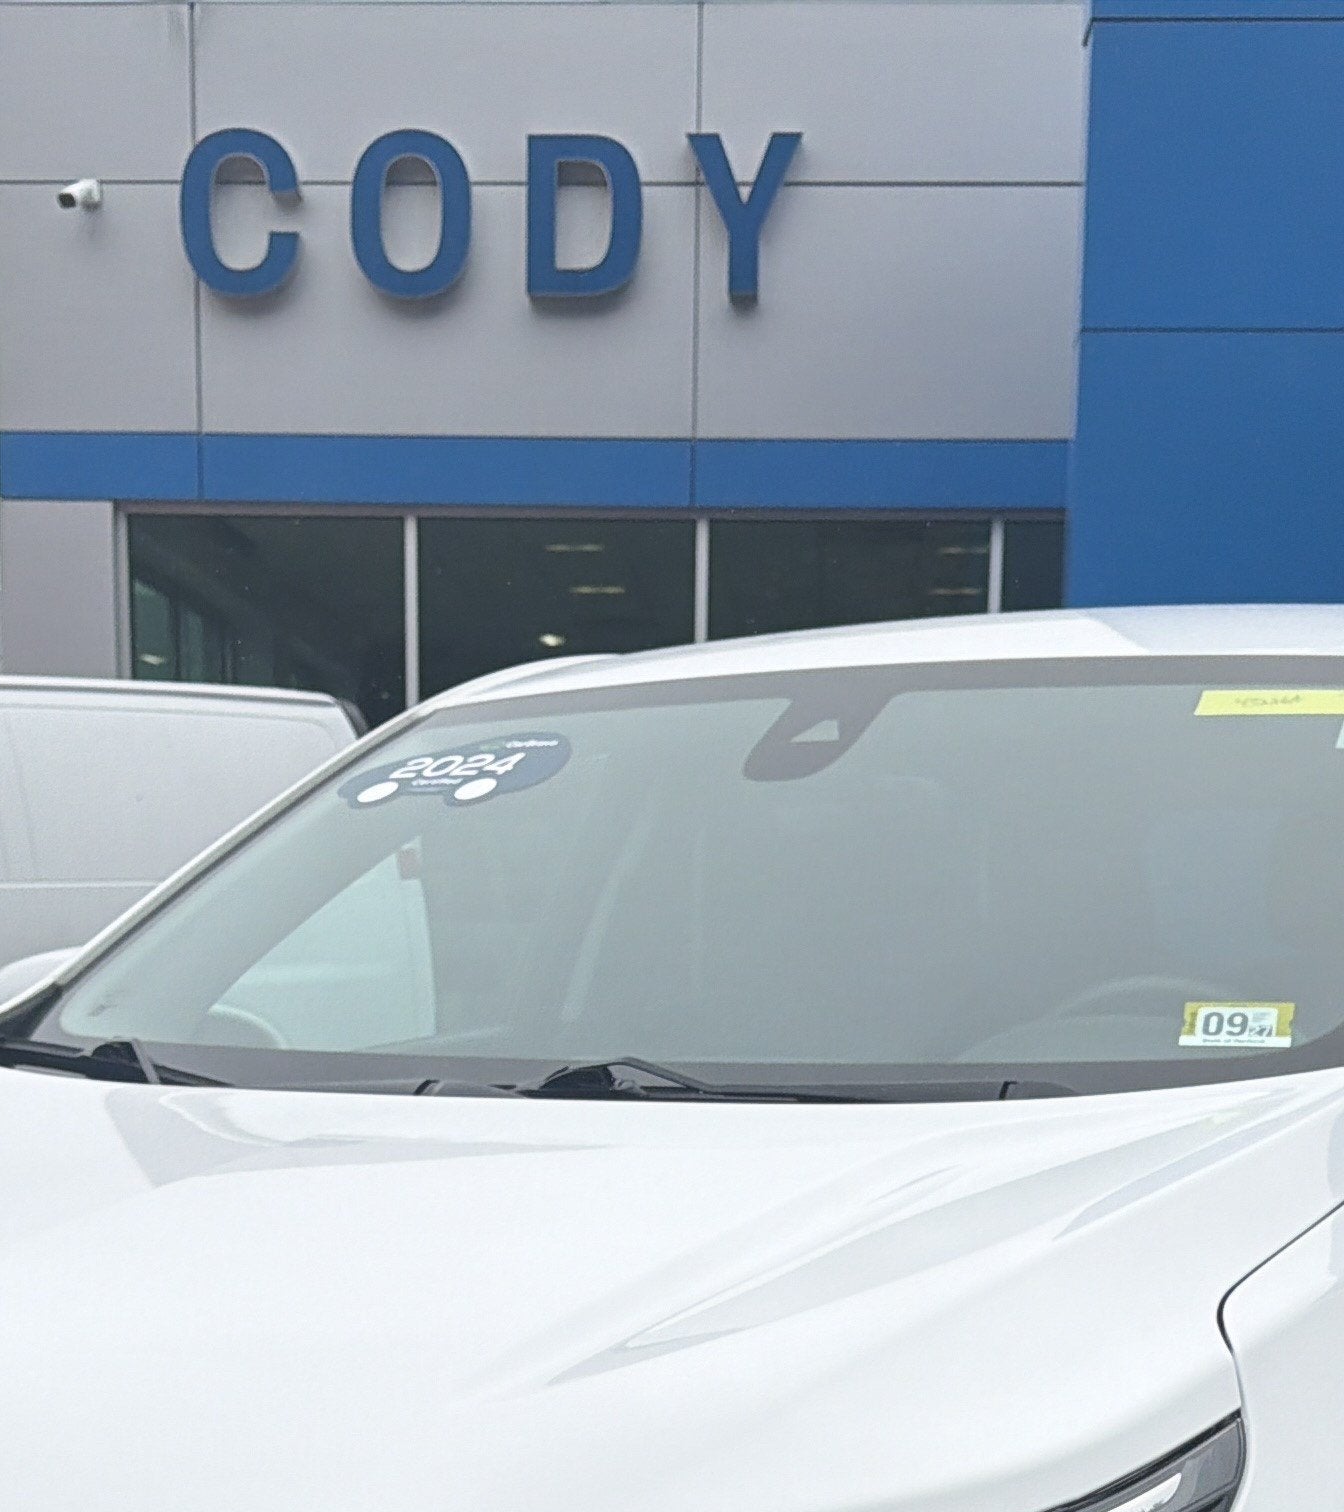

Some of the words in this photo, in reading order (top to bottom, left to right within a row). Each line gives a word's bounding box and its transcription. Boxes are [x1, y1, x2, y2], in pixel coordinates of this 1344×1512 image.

[179, 127, 804, 301] CODY
[389, 752, 526, 778] 2024
[1202, 1012, 1249, 1037] 09
